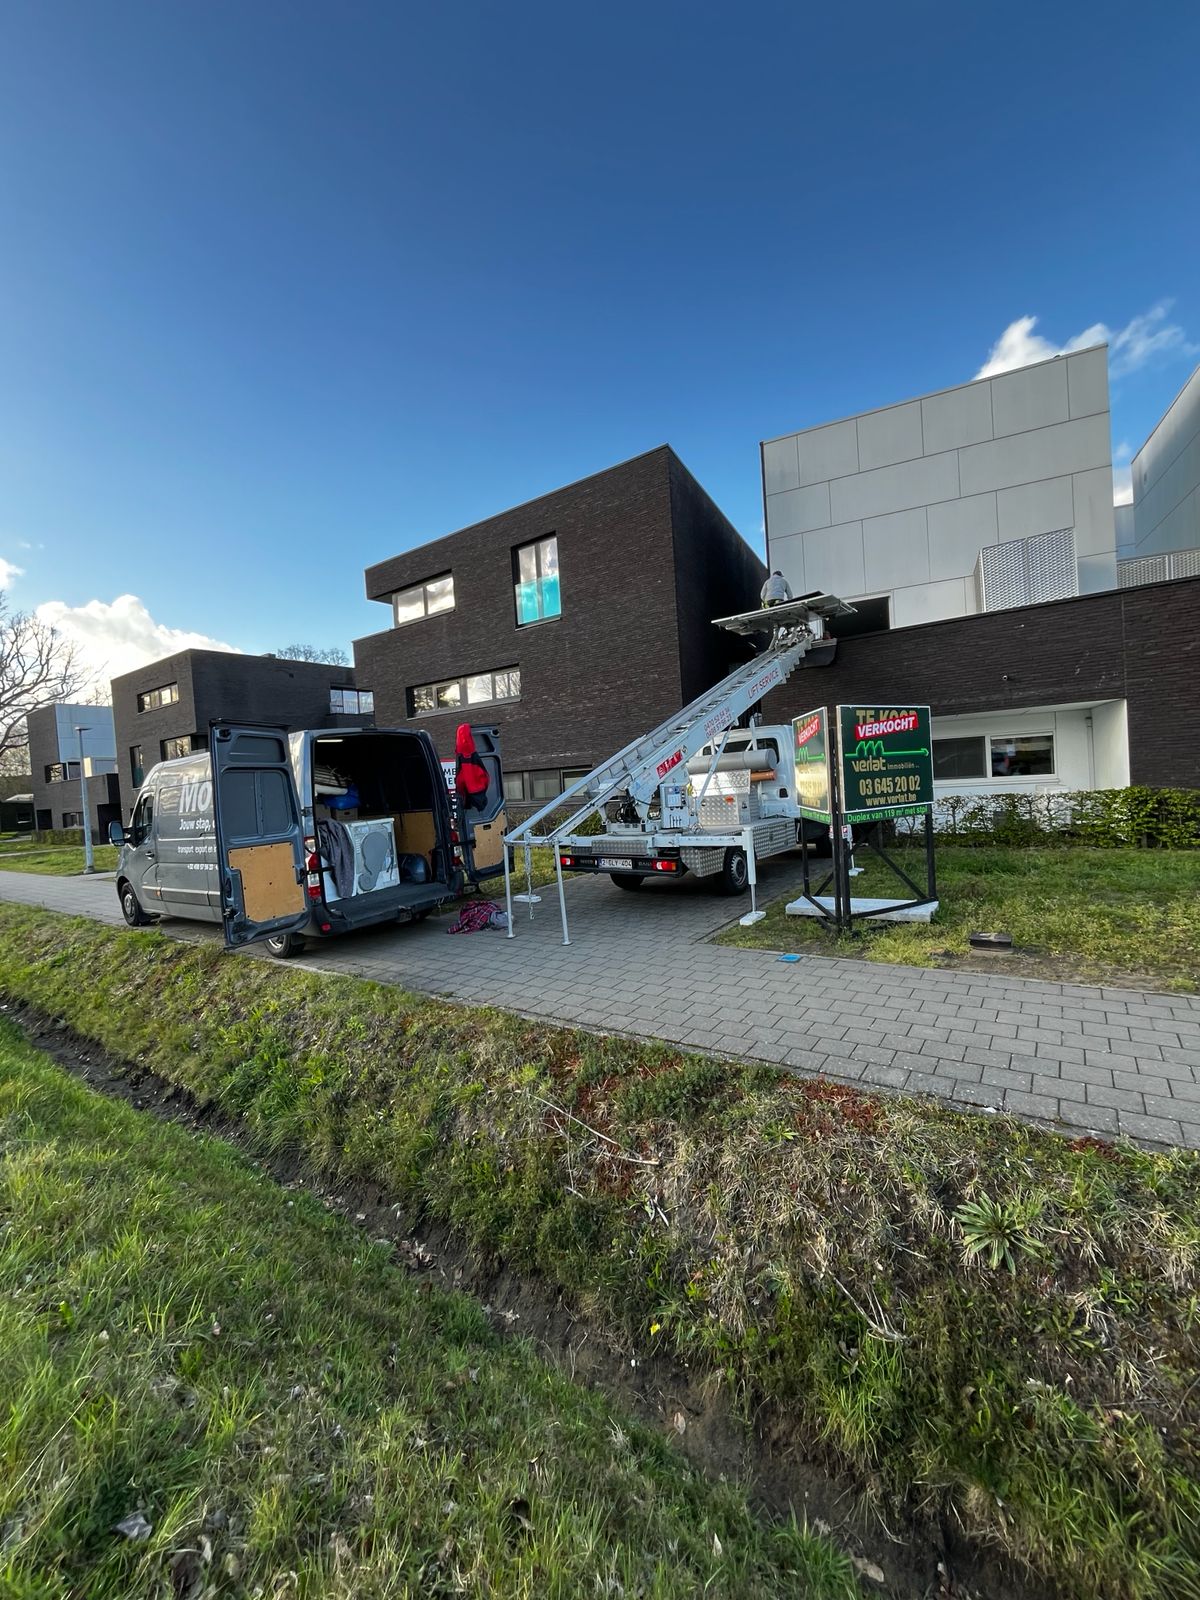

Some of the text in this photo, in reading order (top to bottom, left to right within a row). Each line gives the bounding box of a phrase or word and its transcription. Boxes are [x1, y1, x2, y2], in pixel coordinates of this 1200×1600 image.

[747, 667, 779, 699] LIFT SERVICE
[856, 709, 875, 725] TE
[798, 719, 819, 743] VERKOCHT
[858, 716, 915, 738] VERKOCHT
[860, 775, 920, 796] 03 645 20 02
[866, 793, 917, 806] www.verlat.be
[179, 818, 196, 830] Jouw
[847, 811, 870, 823] Duplex
[871, 811, 883, 819] van
[884, 809, 895, 818] 119
[905, 806, 916, 815] met
